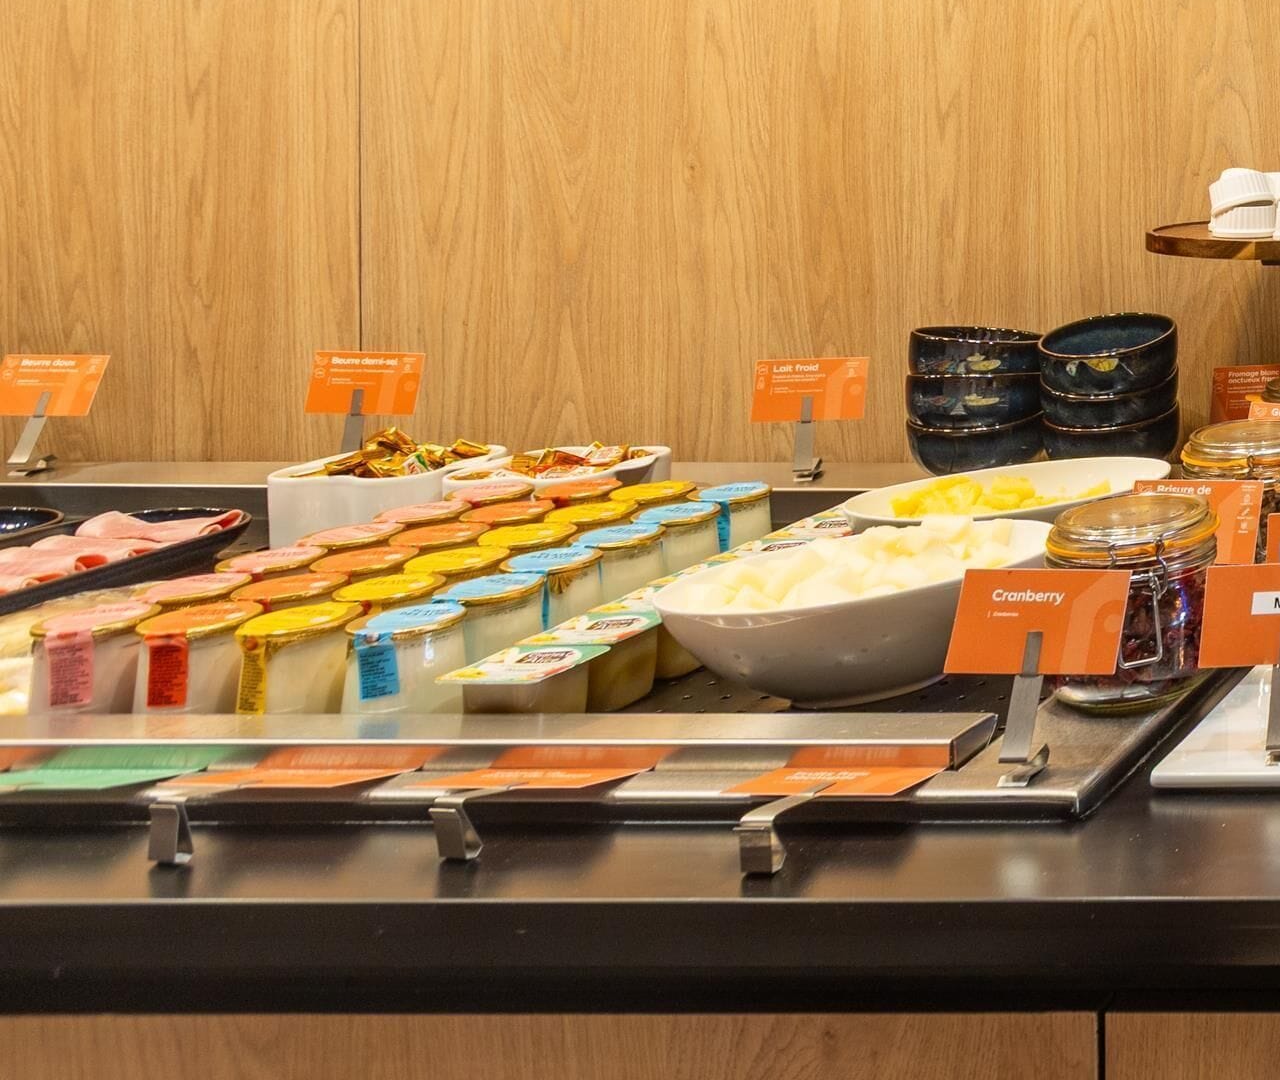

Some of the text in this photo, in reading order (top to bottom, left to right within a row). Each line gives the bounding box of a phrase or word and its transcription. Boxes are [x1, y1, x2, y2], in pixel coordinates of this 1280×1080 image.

[773, 363, 819, 373] Lait froid
[1228, 370, 1258, 379] Fromage
[1228, 376, 1260, 385] onctueux
[1197, 485, 1212, 495] de
[991, 589, 1065, 606] Cranberry
